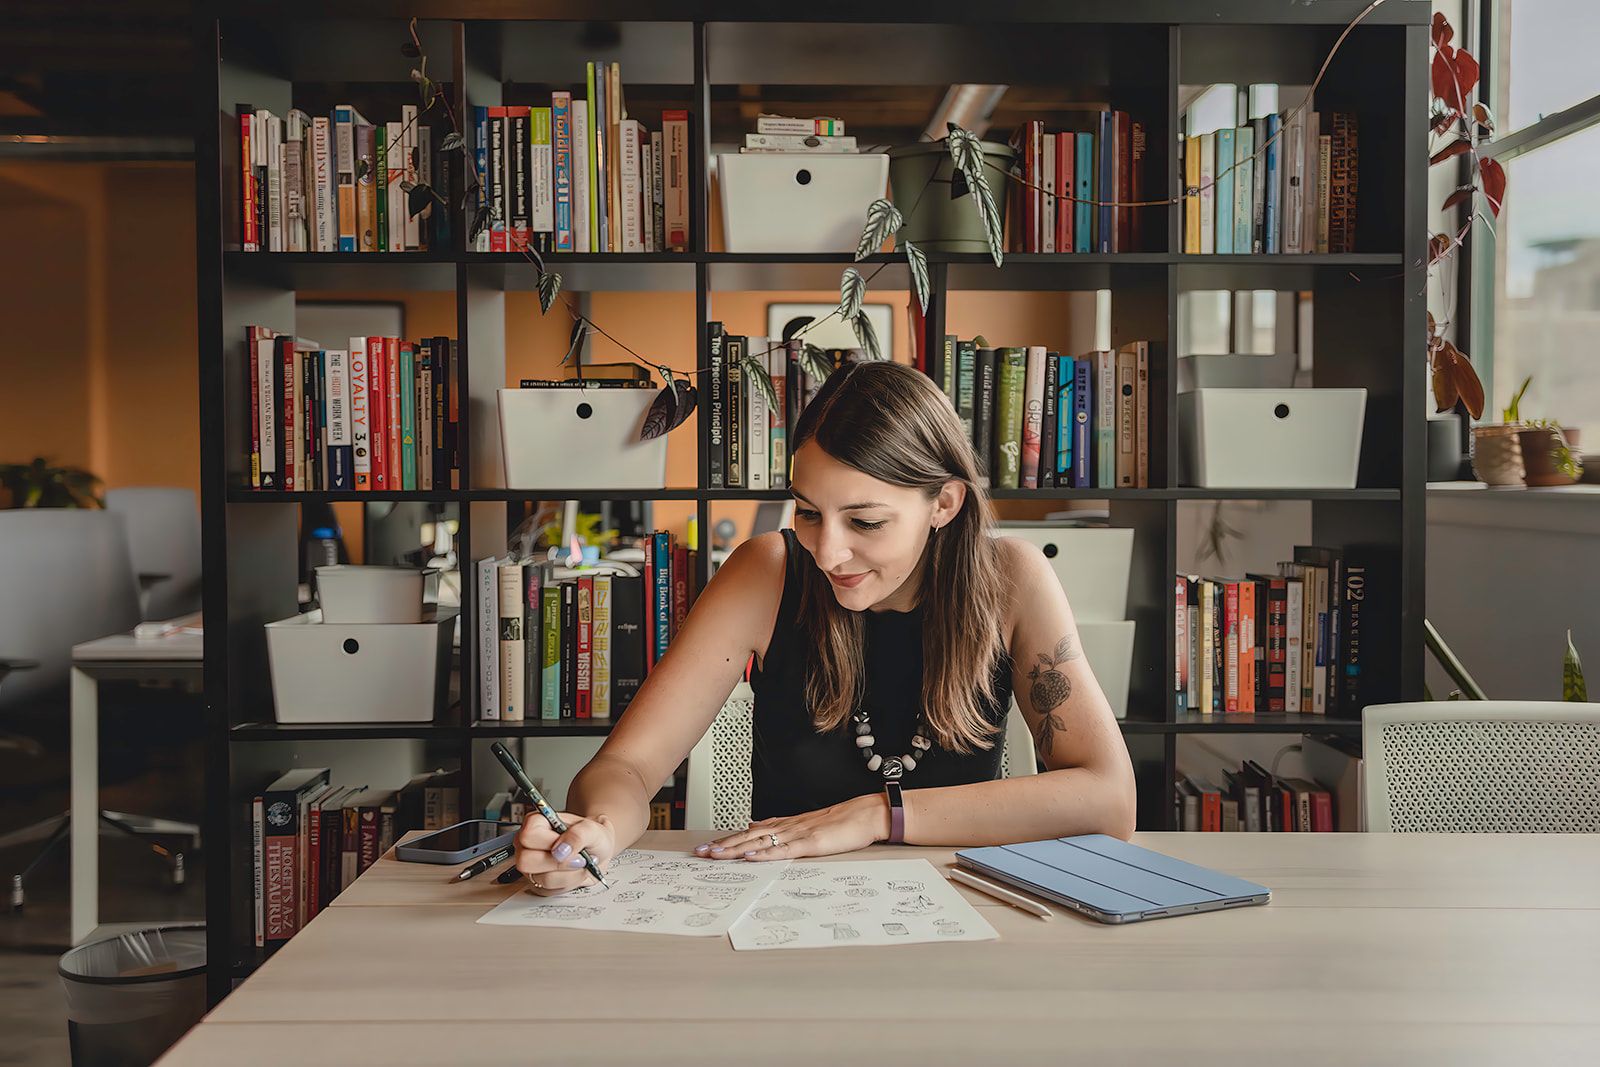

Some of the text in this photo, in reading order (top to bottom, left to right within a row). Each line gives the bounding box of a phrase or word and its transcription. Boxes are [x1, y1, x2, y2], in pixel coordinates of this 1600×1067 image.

[557, 112, 570, 202] Toddler 411
[960, 350, 975, 370] SARA
[710, 336, 722, 445] The Freedom Principle
[1078, 368, 1086, 391] BITE
[352, 351, 367, 458] LOYALTY 3.0
[753, 391, 763, 437] WICKED
[656, 568, 668, 584] Big
[676, 582, 686, 604] CSA
[1346, 567, 1365, 600] 102
[659, 586, 668, 611] Book
[659, 611, 668, 622] of
[577, 653, 590, 690] RUSSIA
[362, 832, 374, 868] ANNA
[268, 841, 282, 934] THESAURUS
[281, 846, 294, 929] ROGET'S A-Z
